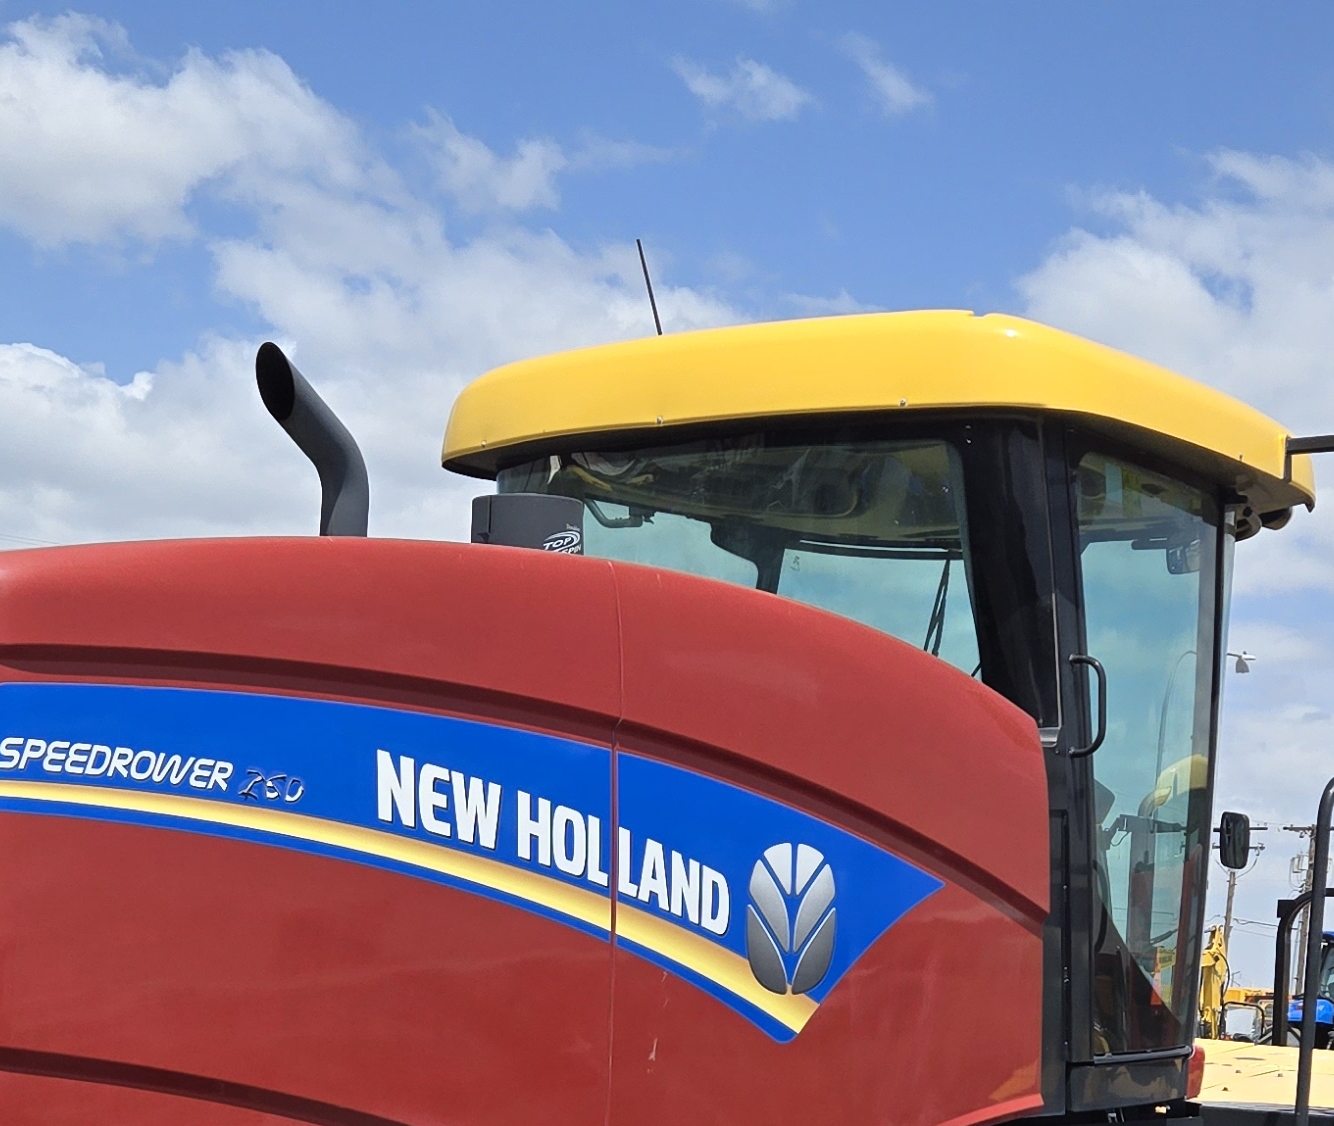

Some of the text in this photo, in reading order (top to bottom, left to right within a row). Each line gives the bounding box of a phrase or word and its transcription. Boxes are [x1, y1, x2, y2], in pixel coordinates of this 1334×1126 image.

[543, 537, 571, 551] TOP
[376, 748, 730, 937] NEW HOLLAND
